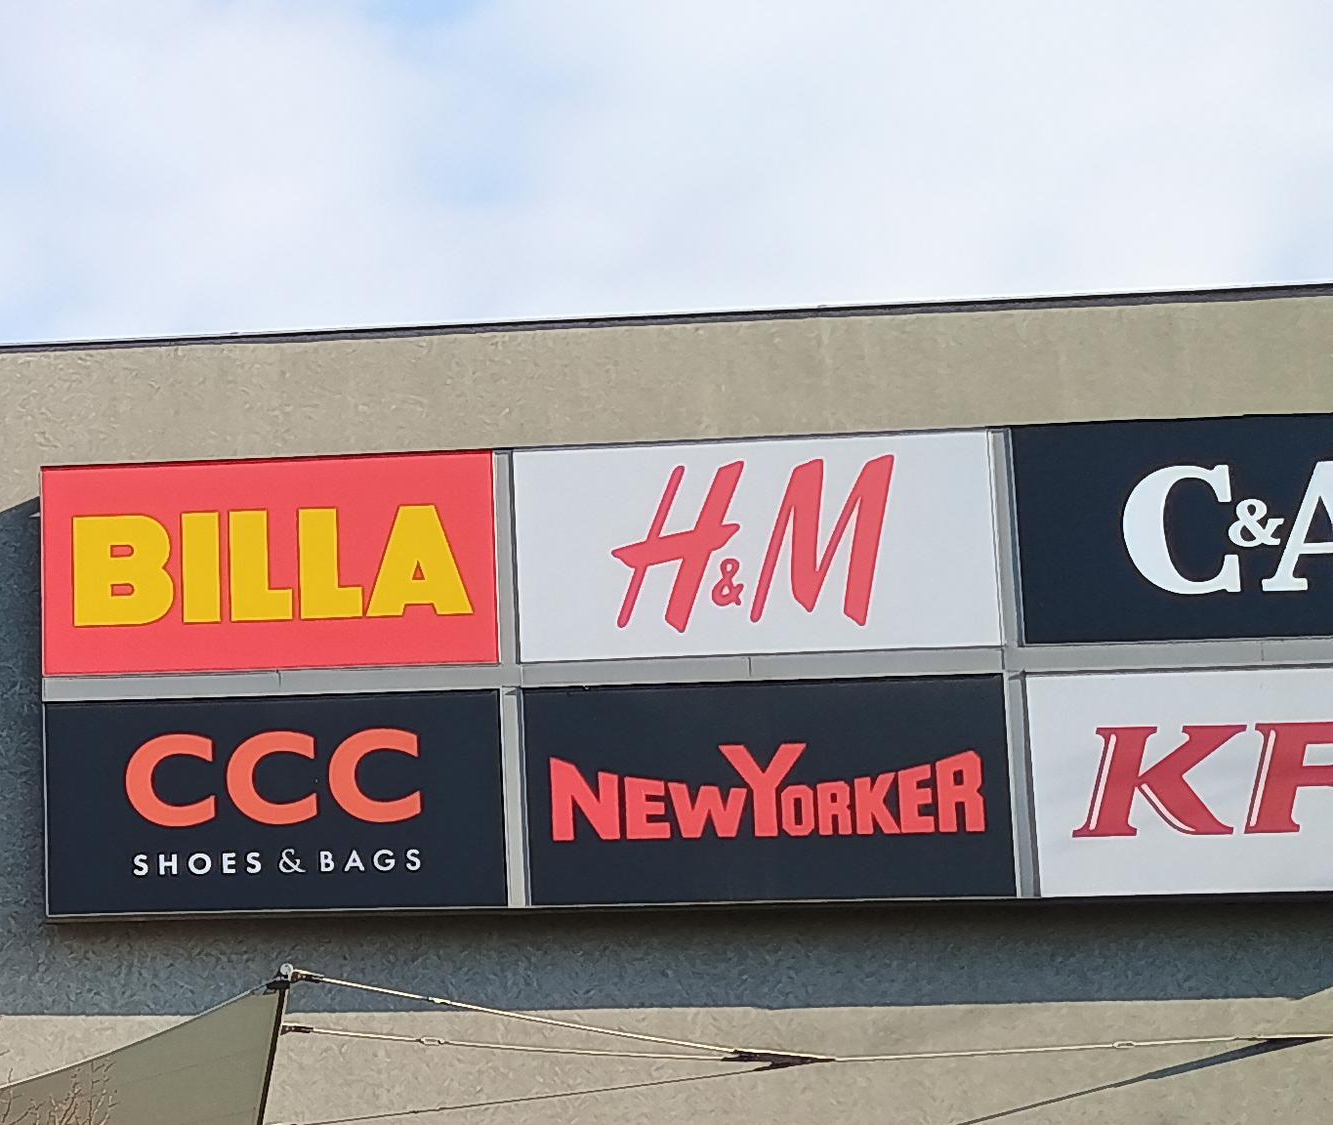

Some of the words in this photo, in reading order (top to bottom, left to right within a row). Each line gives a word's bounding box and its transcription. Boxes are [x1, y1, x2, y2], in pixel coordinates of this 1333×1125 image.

[72, 504, 474, 627] BILLA
[611, 454, 894, 633] H&M
[124, 727, 422, 827] CCC
[132, 852, 262, 876] SHOES
[278, 848, 306, 874] &
[318, 848, 422, 873] BAGS
